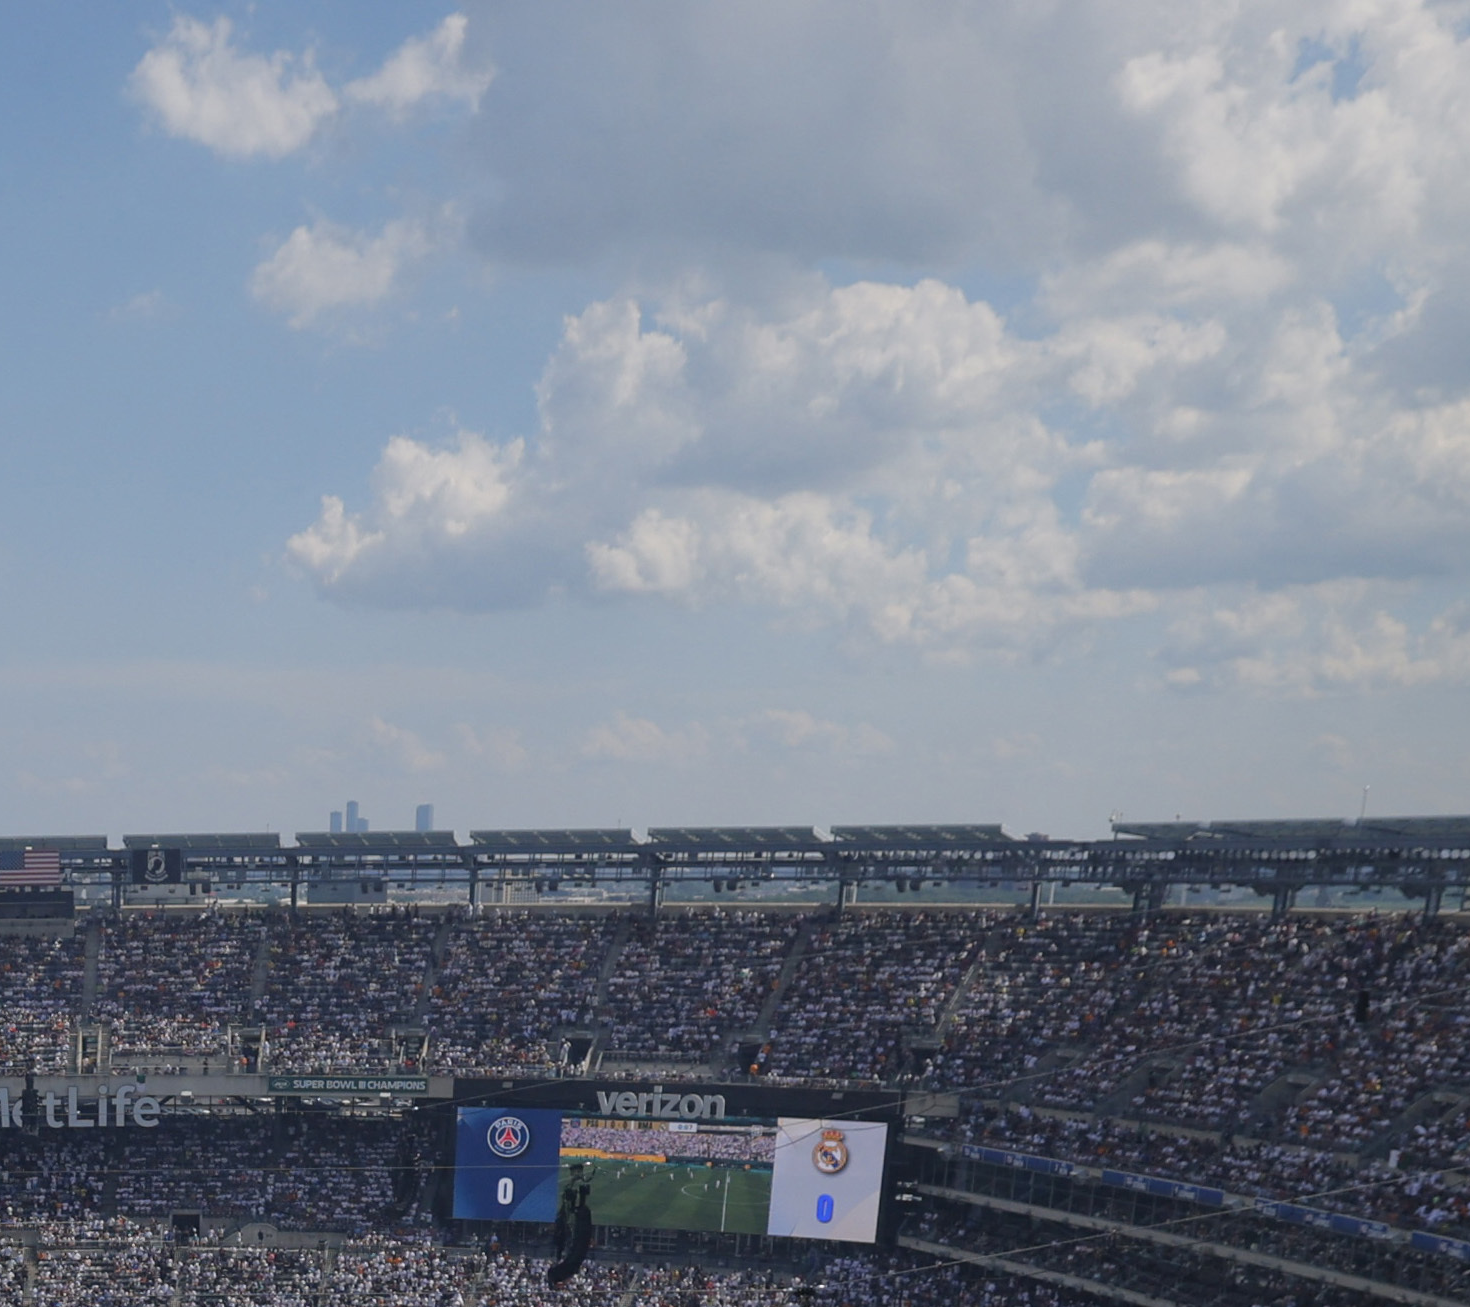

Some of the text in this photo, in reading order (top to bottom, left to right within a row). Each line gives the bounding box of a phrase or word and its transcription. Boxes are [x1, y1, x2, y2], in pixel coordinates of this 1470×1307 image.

[293, 1080, 325, 1089] SUPER
[327, 1080, 357, 1090] BOWL
[367, 1081, 426, 1090] CHAMPIONS
[597, 1085, 726, 1119] verizon
[494, 1118, 523, 1130] PARIS
[498, 1177, 514, 1205] 0
[816, 1194, 834, 1223] 0
